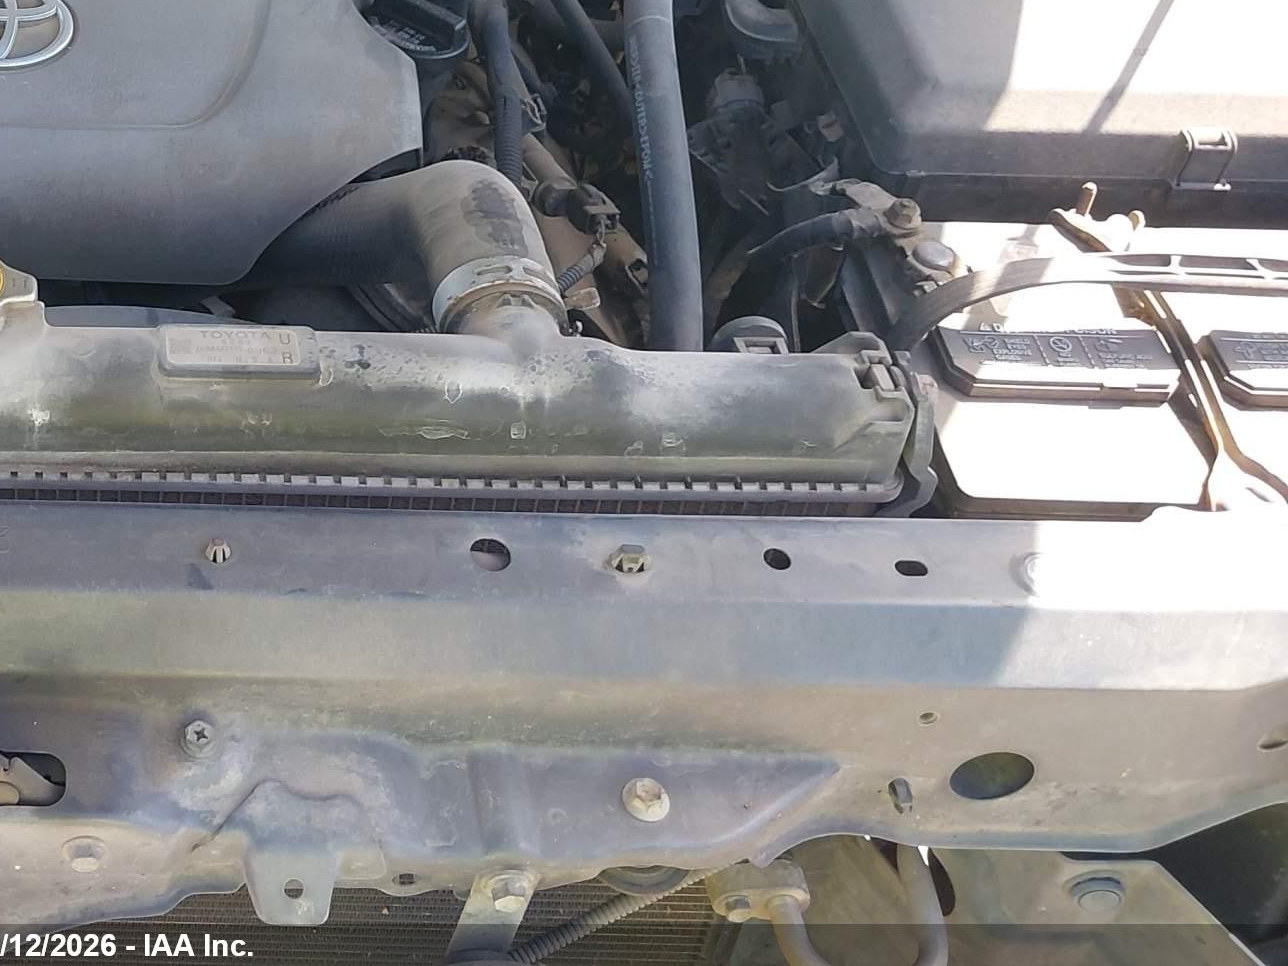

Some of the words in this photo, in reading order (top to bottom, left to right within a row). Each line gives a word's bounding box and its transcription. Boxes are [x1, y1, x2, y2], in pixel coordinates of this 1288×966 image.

[199, 330, 271, 339] TOYOTA
[279, 333, 291, 345] U
[281, 351, 294, 364] R
